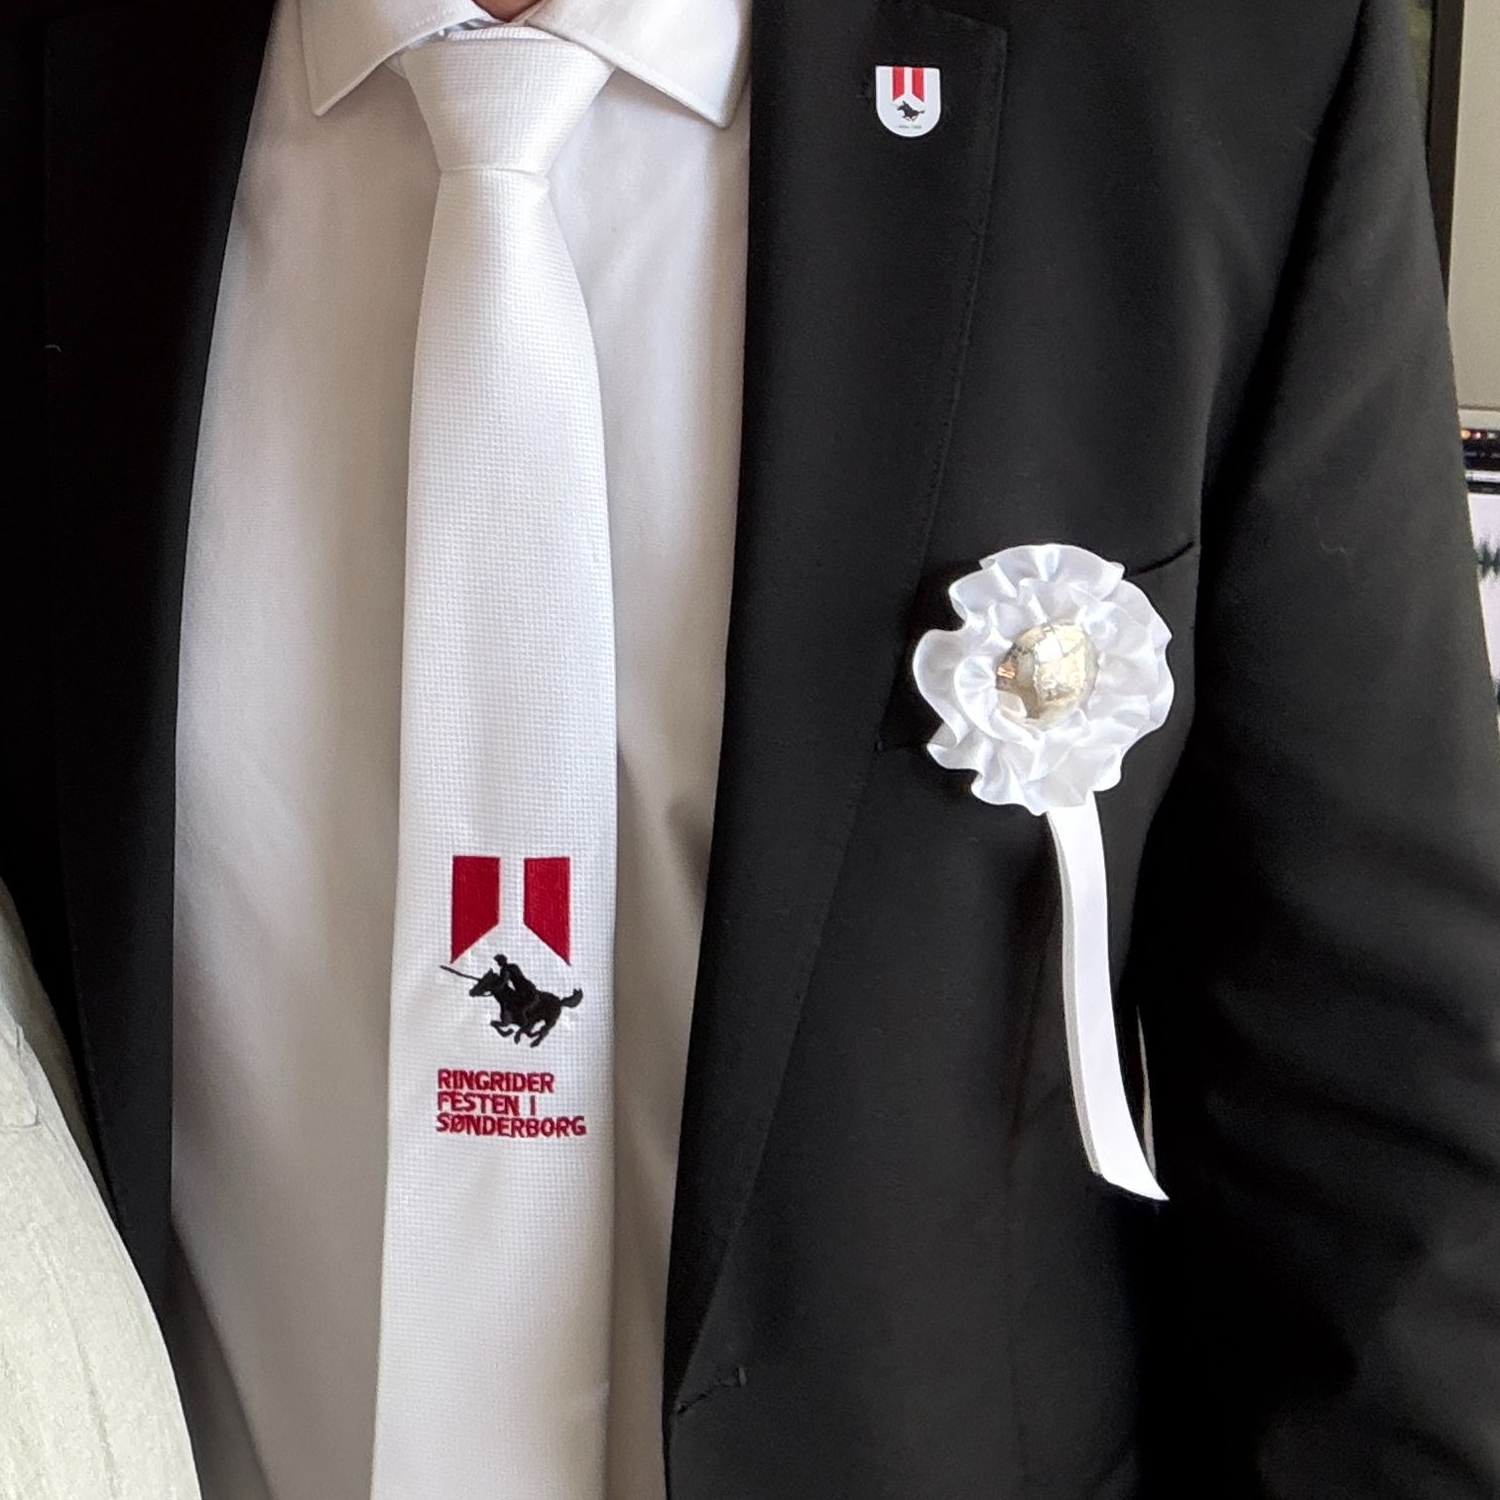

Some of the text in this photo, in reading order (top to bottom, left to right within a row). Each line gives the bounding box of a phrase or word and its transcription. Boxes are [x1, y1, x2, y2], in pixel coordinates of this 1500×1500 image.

[437, 1068, 555, 1093] RINGRIDER
[437, 1091, 537, 1116] FESTEN I
[436, 1114, 587, 1138] SØNDERBORG
